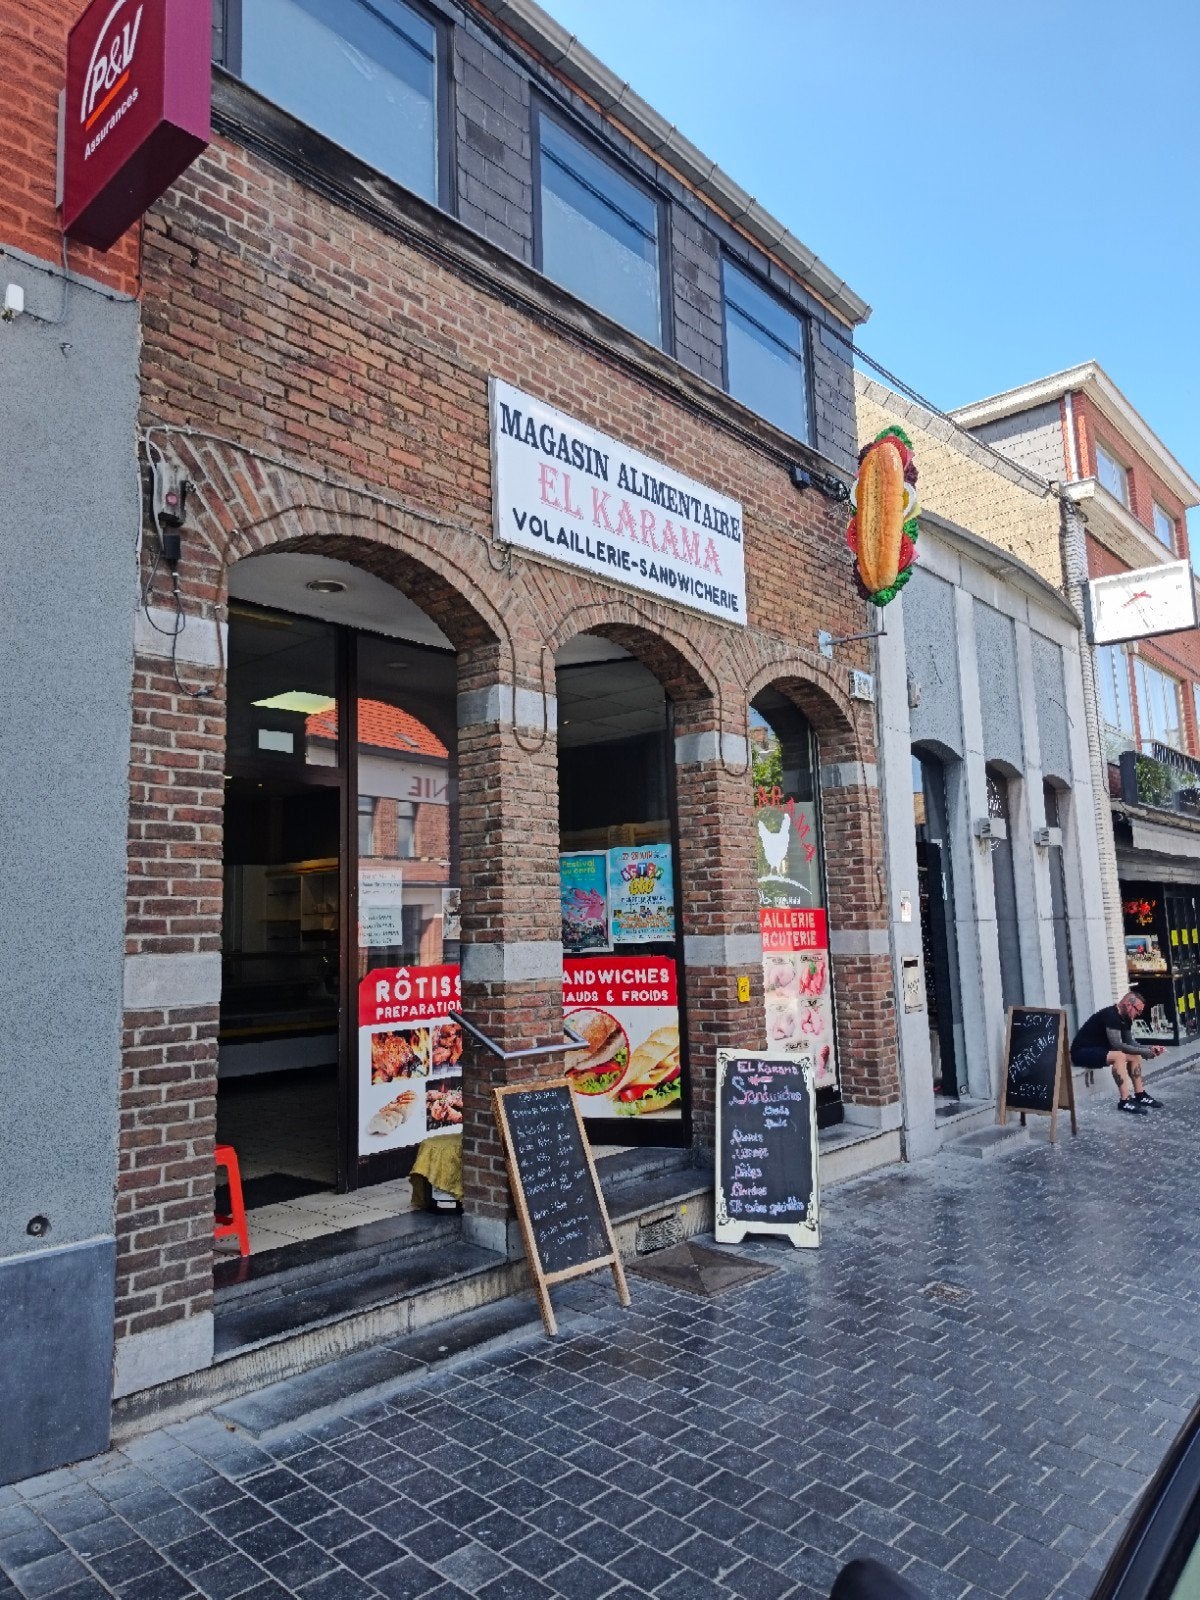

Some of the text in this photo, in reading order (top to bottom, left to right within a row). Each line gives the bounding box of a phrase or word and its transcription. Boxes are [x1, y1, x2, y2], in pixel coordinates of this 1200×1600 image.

[88, 4, 144, 114] P&V
[84, 87, 139, 161] Assurances
[499, 402, 742, 543] MAGASIN ALIMENTAIRE
[538, 462, 723, 577] EL KARAMA
[512, 507, 740, 613] VOLAILLERIE-SANDWICHERIE
[761, 912, 816, 929] AILLERIE
[562, 990, 599, 1003] AUDS
[622, 989, 669, 1002] FROIDS
